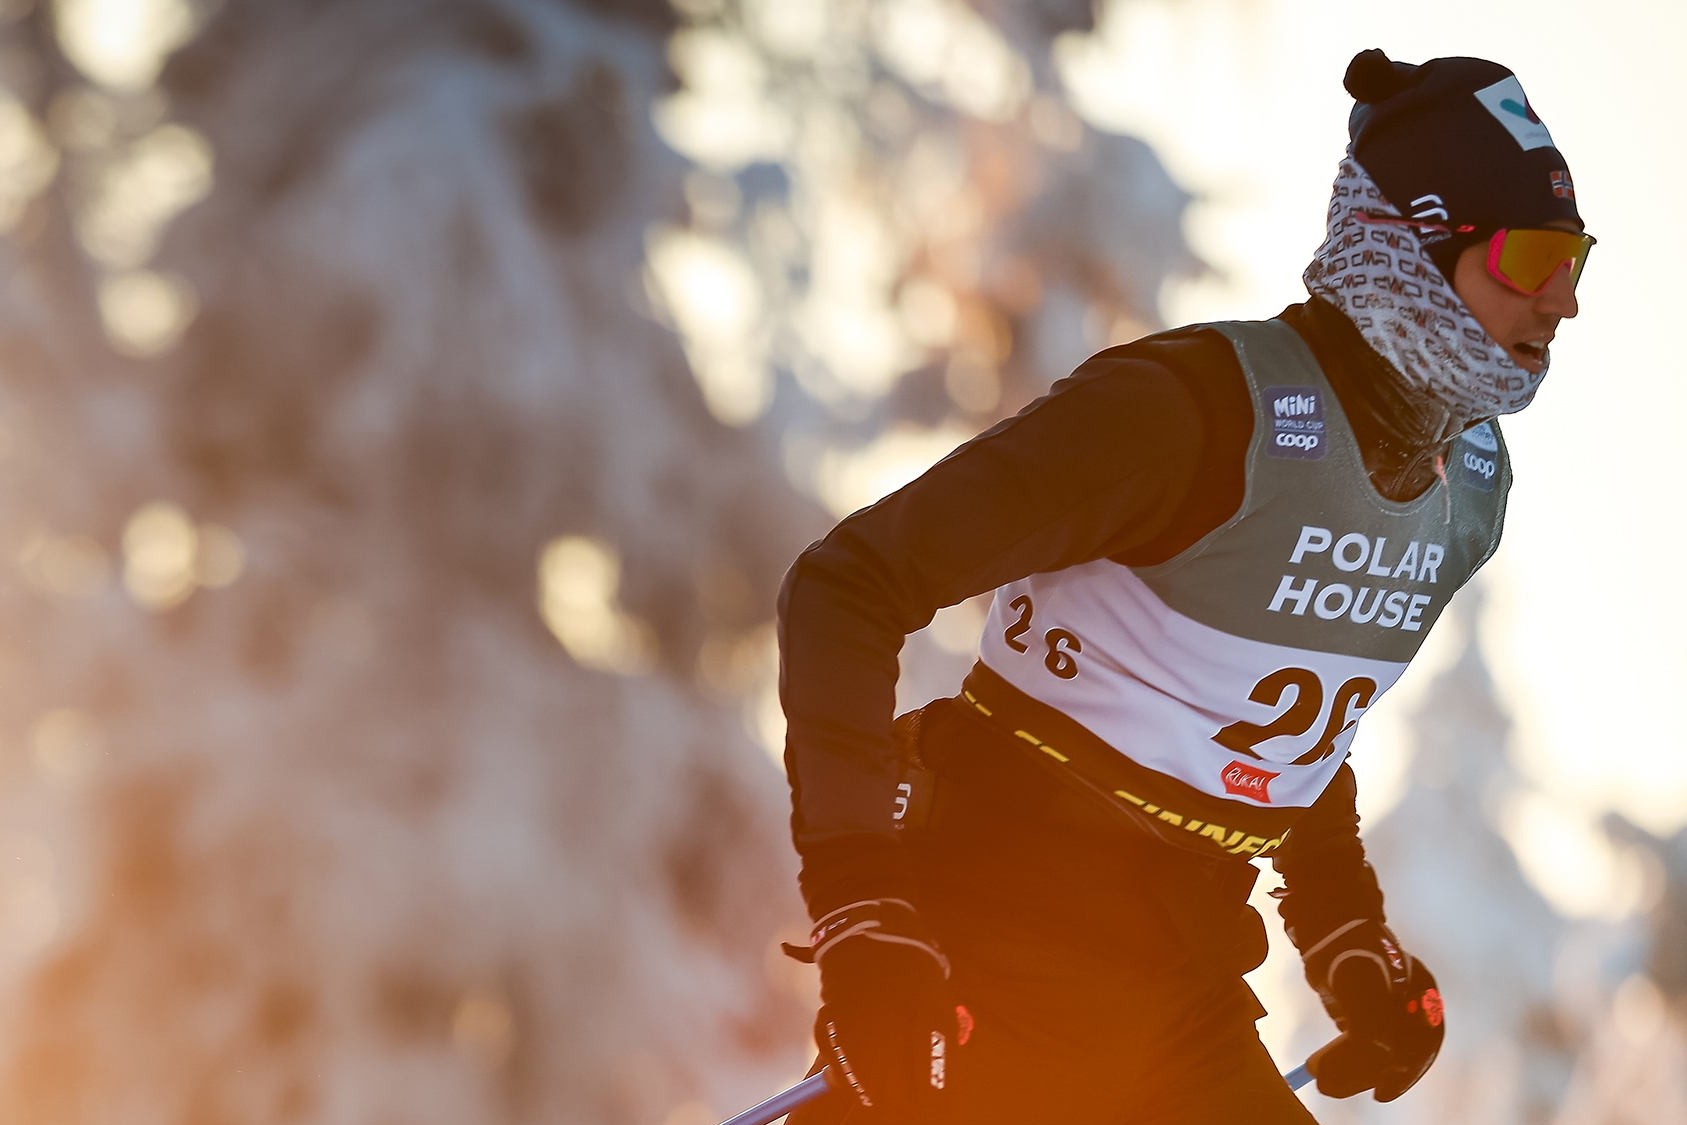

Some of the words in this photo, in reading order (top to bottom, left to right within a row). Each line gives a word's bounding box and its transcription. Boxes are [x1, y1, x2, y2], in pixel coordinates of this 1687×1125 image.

[1275, 433, 1319, 451] coop
[1464, 452, 1495, 479] coop
[1288, 525, 1445, 584] POLAR
[1266, 575, 1432, 632] HOUSE
